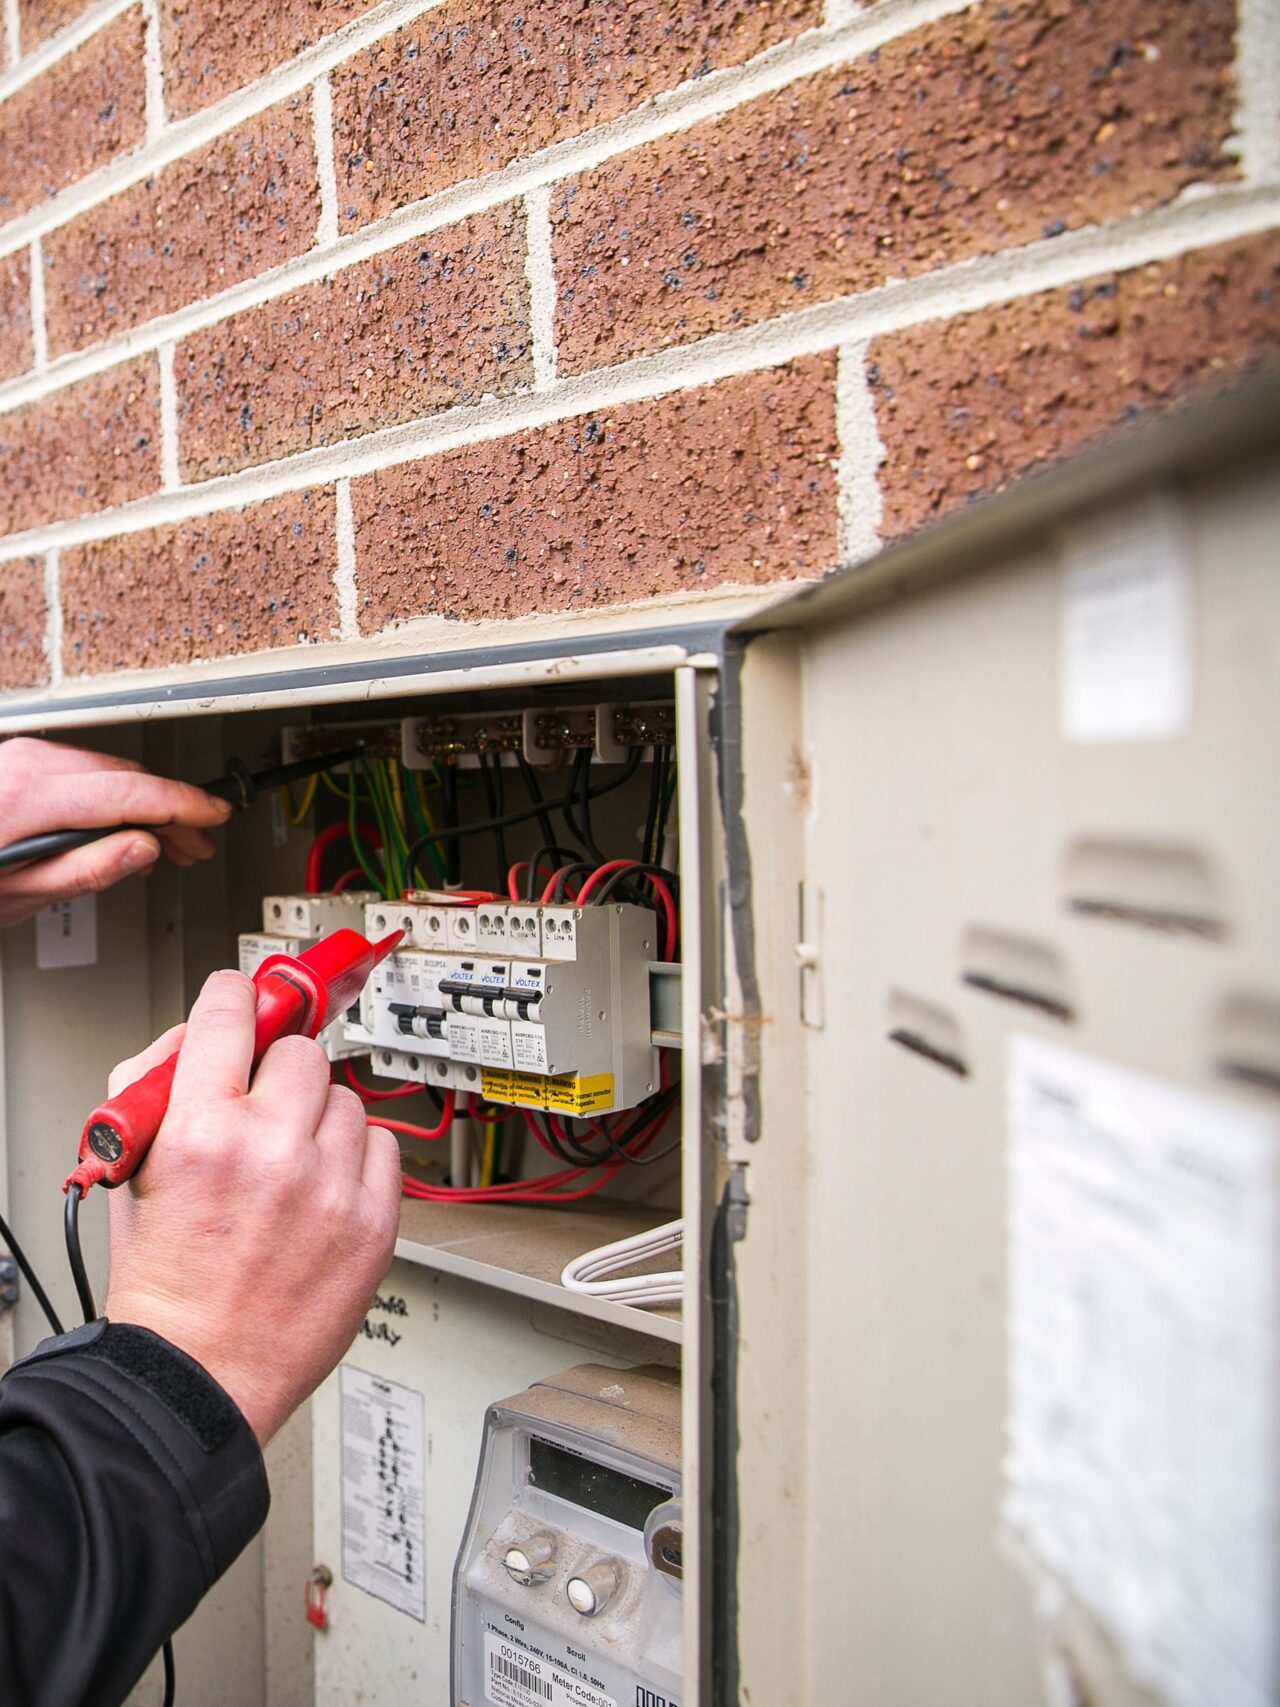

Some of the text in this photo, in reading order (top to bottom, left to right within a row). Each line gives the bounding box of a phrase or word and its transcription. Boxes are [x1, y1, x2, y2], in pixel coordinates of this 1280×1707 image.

[450, 971, 473, 981] VOLTEX
[481, 975, 506, 984] VOLTEX
[515, 978, 541, 987] VOLTEX
[504, 1614, 525, 1631] Config
[491, 1624, 510, 1640] Phase,
[514, 1636, 529, 1650] Wire,
[529, 1645, 545, 1659] 240V,
[590, 1676, 606, 1690] 50Hz
[501, 1645, 541, 1675] 0015766
[566, 1645, 586, 1662] Scroll
[552, 1672, 574, 1691] Meter
